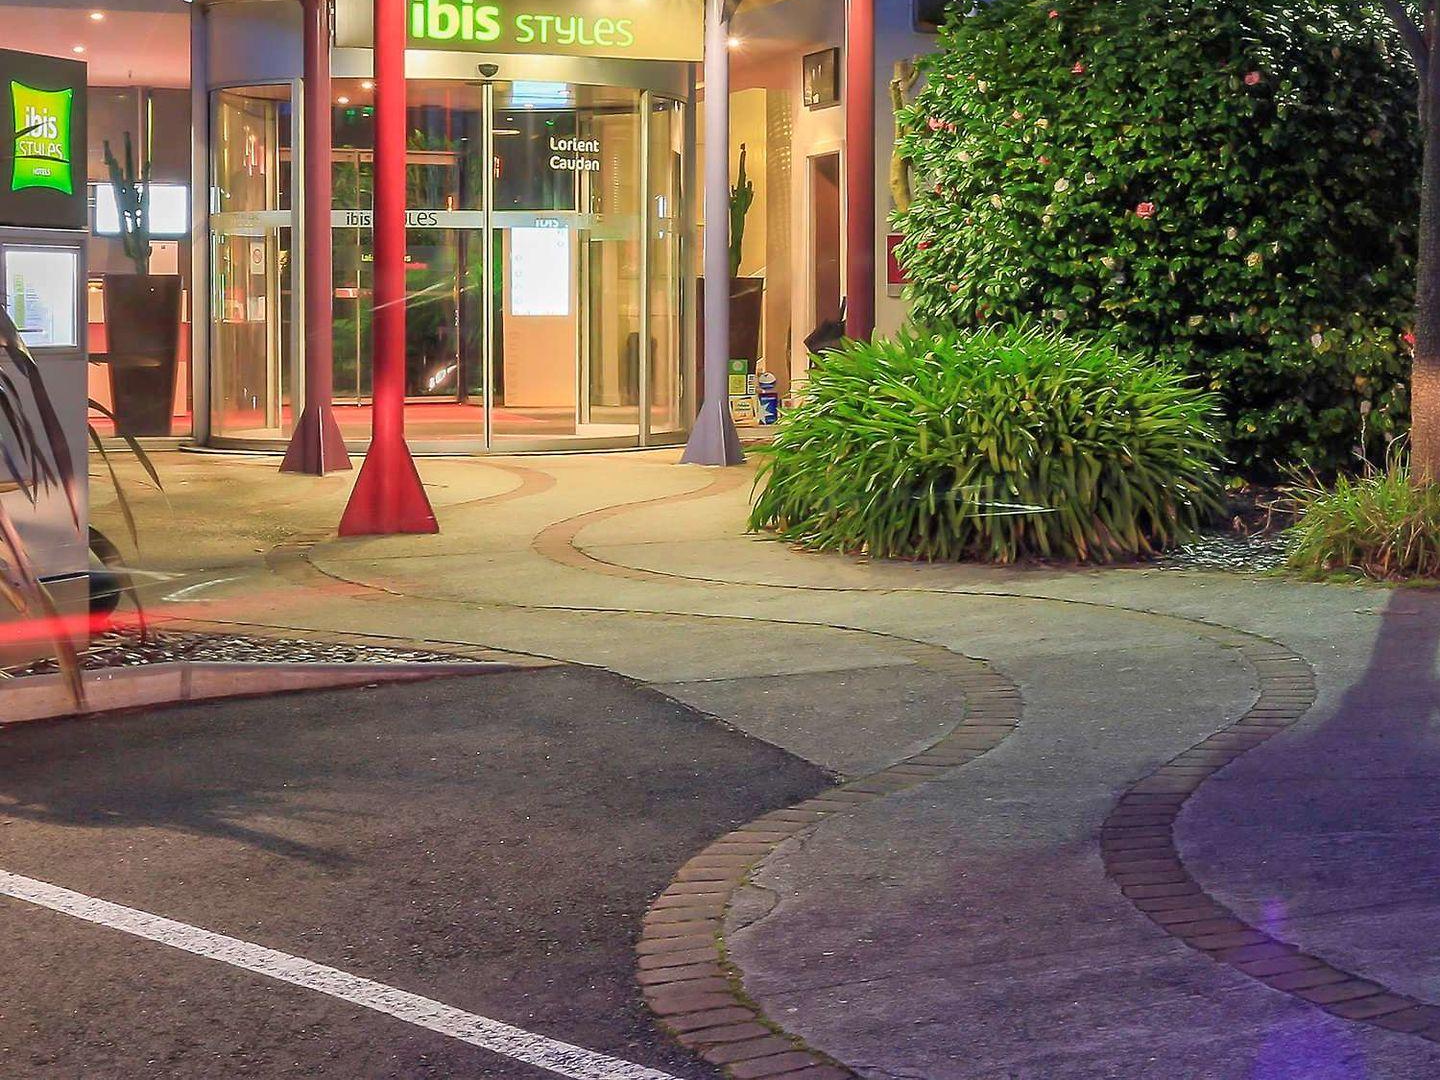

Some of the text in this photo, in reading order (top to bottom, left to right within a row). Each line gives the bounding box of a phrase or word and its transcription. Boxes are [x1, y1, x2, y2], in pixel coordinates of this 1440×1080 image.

[25, 106, 58, 140] ibis
[549, 136, 600, 153] Lorient
[549, 155, 600, 171] Caudan
[346, 212, 371, 226] ibis
